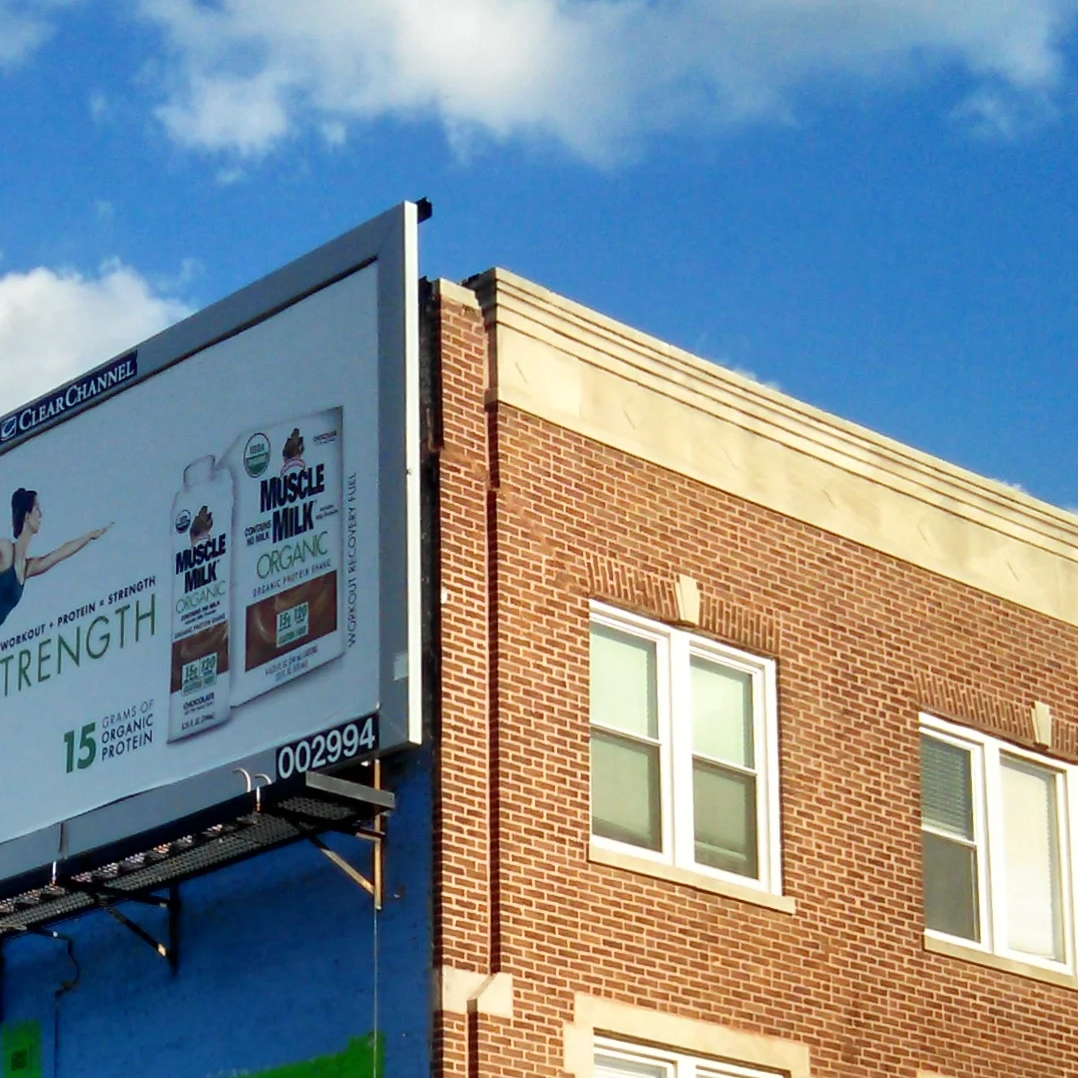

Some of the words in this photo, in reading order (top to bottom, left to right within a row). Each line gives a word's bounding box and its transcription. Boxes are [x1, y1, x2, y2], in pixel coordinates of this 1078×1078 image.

[260, 464, 325, 514] MUSCLE
[347, 472, 357, 501] FUEL
[272, 501, 314, 544] MILK
[347, 507, 357, 574] RECOVERY
[175, 533, 226, 575] MUSCLE
[256, 531, 329, 579] ORGANIC
[176, 580, 226, 614] ORGANIC
[185, 561, 217, 594] MILK
[253, 580, 281, 598] ORGANIC
[0, 624, 45, 651] WORKOUT
[57, 602, 96, 627] PROTEIN
[107, 576, 156, 604] STRENGTH
[347, 579, 357, 648] WORKOUT
[101, 714, 154, 744] ORGANIC
[102, 706, 138, 729] GRAMS
[140, 699, 154, 715] OF
[63, 722, 98, 774] 15
[102, 730, 153, 761] PROTEIN
[278, 718, 375, 780] 002994
